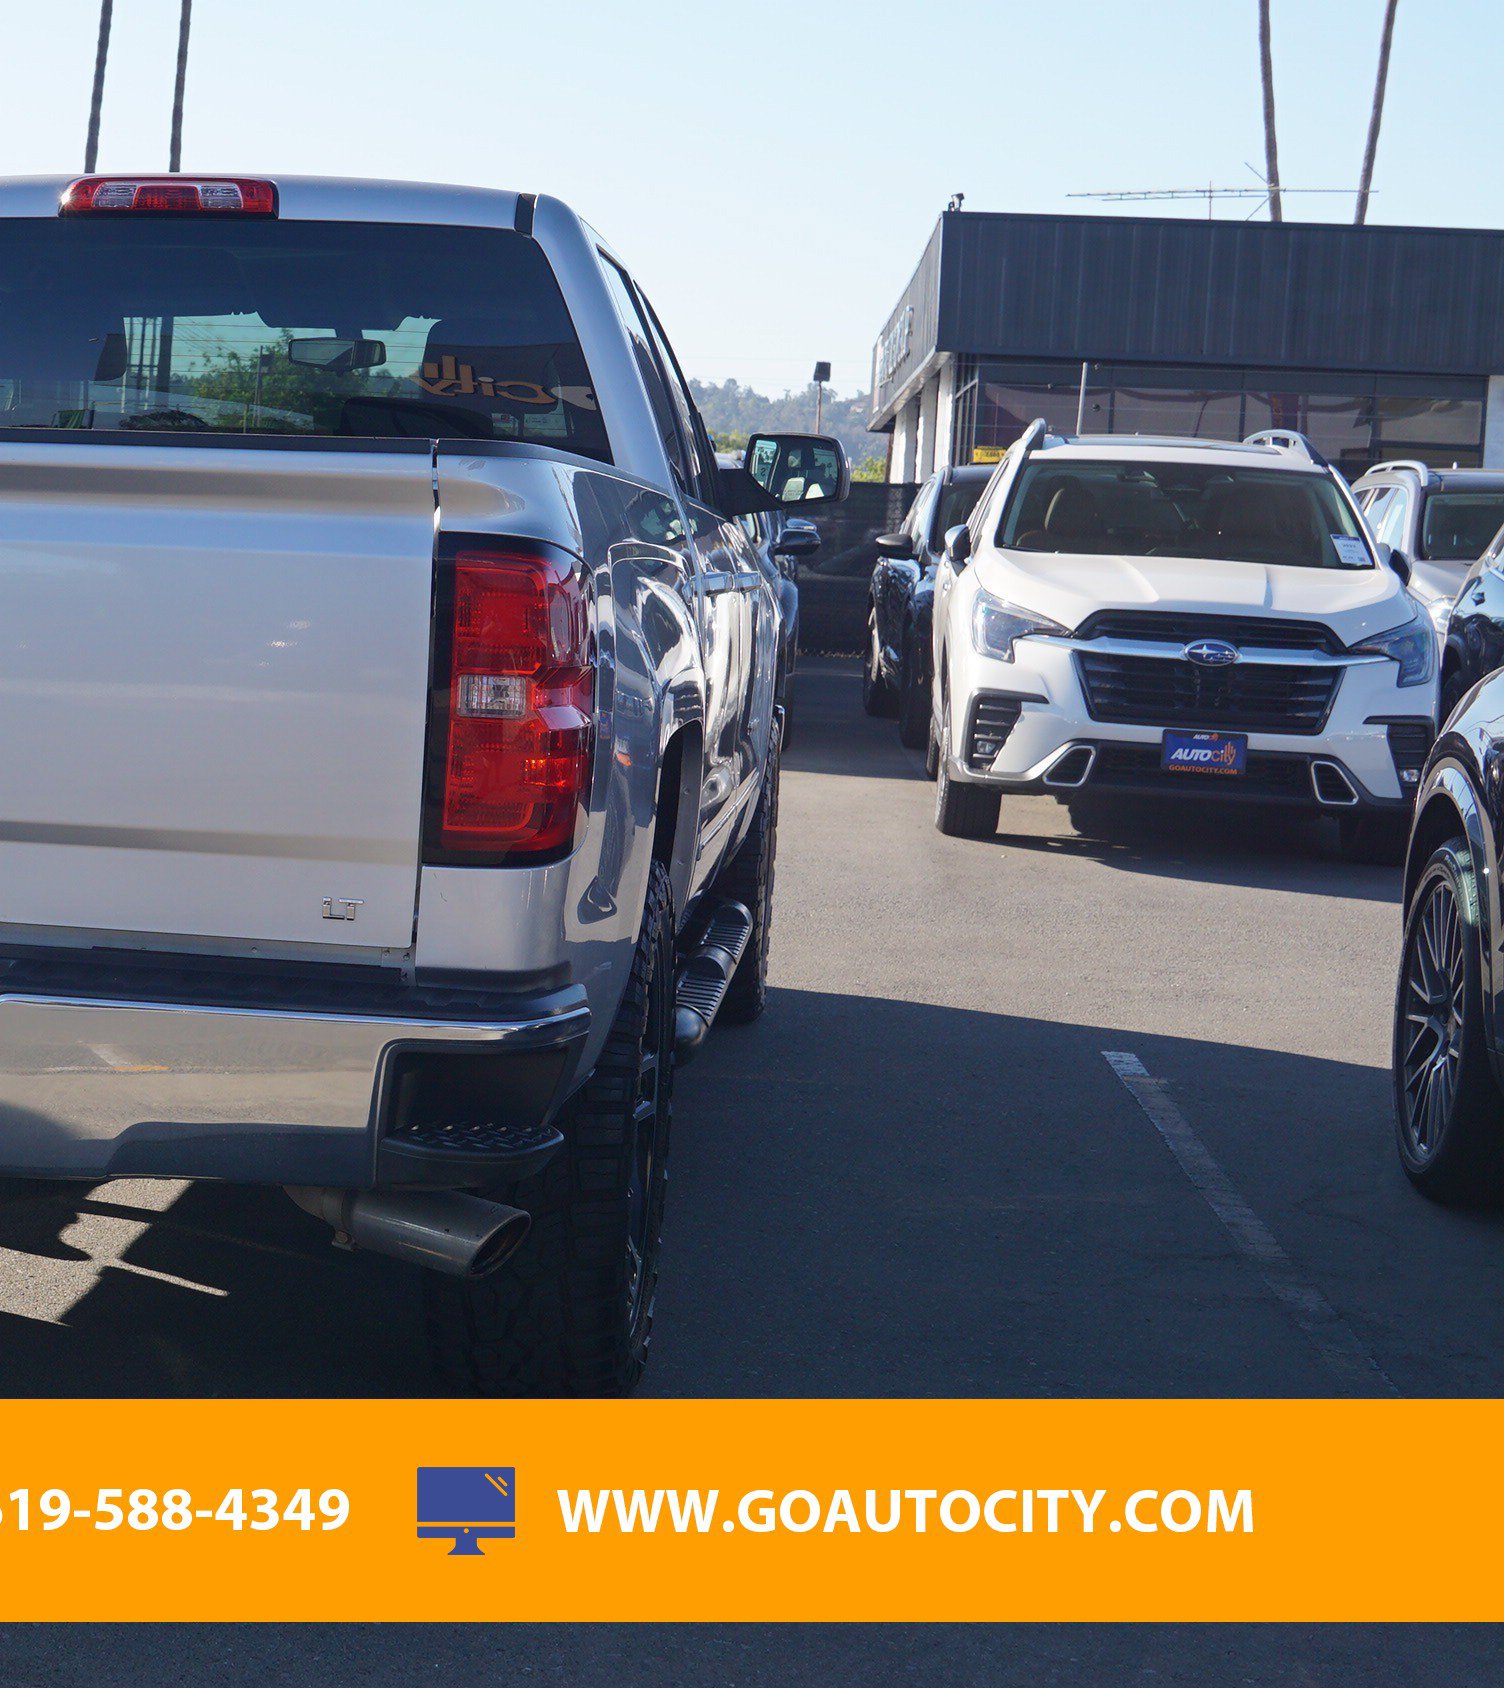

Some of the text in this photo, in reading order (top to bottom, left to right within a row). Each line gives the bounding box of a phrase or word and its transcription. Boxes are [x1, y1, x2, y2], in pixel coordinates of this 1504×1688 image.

[1170, 743, 1236, 766] AUTOCity
[1168, 764, 1238, 775] GOAUTOCITY.COM
[321, 896, 365, 921] LT
